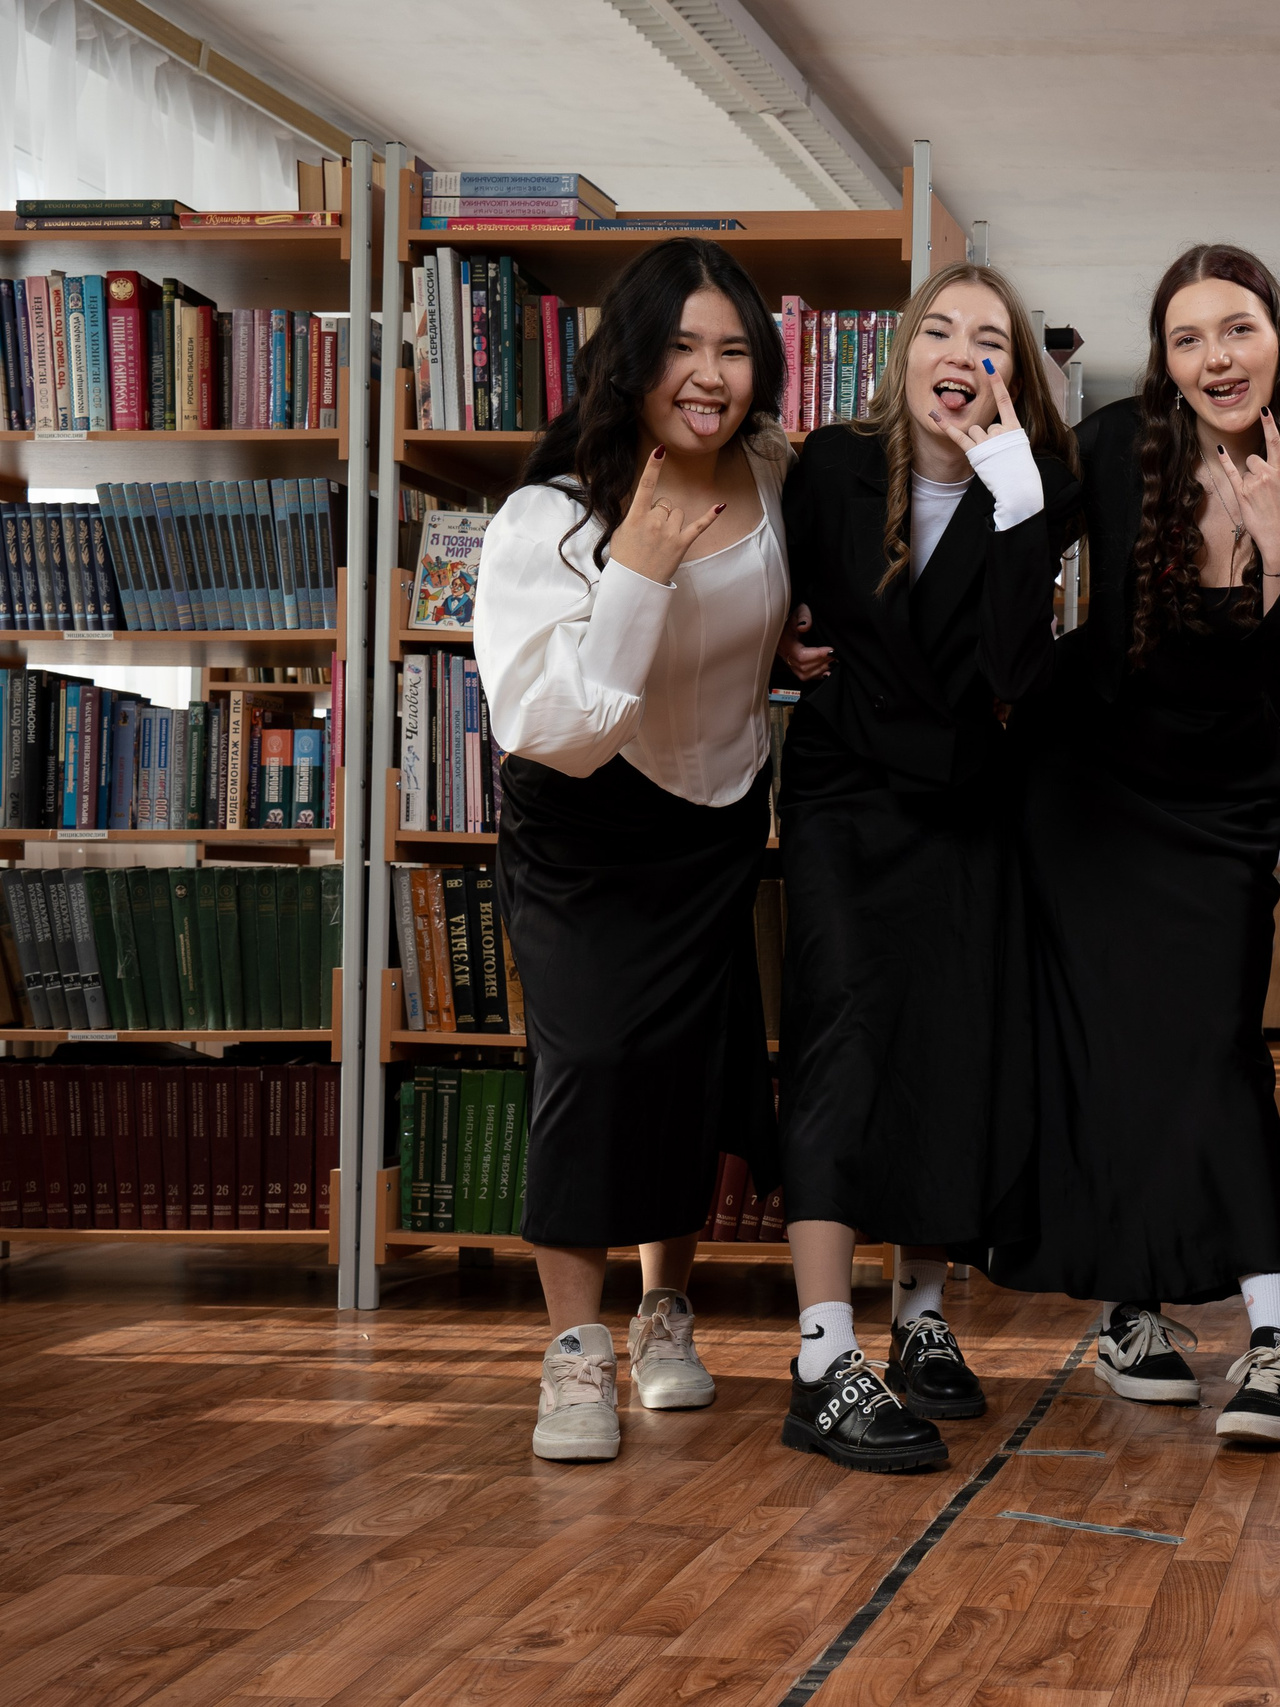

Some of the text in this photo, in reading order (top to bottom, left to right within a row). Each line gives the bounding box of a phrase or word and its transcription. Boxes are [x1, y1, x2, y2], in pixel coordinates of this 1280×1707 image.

[462, 176, 508, 184] ШКОЛЬНИКА
[510, 176, 559, 184] СПРАВОЧНИК
[205, 214, 250, 225] Кулинария
[426, 268, 435, 306] РОССИИ
[31, 296, 47, 385] ВЕЛИКИХ ИМЁН
[87, 295, 101, 384] ВЕЛИКИХ ИМЁН
[429, 308, 438, 356] СЕРЕДИНЕ
[785, 323, 797, 375] ДЕВОЧЕК
[323, 336, 333, 405] Николай КУЗНЕЦОВ
[113, 363, 128, 414] РУССКИЕ
[430, 534, 440, 545] Я
[445, 547, 472, 558] МИР
[27, 675, 37, 743] ИНФОРМАТИКА
[405, 676, 422, 740] Человек
[81, 701, 92, 824] МИРОВАЯ ХУДОЖЕСТВЕННАЯ КУЛЬТУРА
[229, 699, 241, 823] ВИДЕОМОНТАЖ НА ПК
[45, 755, 56, 812] ЕСТЕСТВОЗНАНИЕ
[35, 883, 52, 940] ЭНЦИКЛОПЕДИЯ
[69, 884, 82, 942] МАТЕМАТИЧЕСКАЯ
[76, 883, 91, 940] ЭНЦИКЛОПЕДИЯ
[449, 914, 470, 987] МУЗЫКА
[480, 901, 498, 998] БИОЛОГИЯ
[462, 1104, 475, 1186] ЖИЗНЬ РАСТЕНИЙ
[480, 1104, 496, 1186] ЖИЗНЬ РАСТЕНИЙ
[500, 1103, 516, 1186] ЖИЗНЬ РАСТЕНИЙ
[25, 1180, 37, 1193] 18
[49, 1181, 60, 1194] 19
[74, 1183, 86, 1195] 20
[97, 1183, 108, 1194] 21
[120, 1182, 132, 1194] 22
[143, 1183, 156, 1195] 23
[168, 1184, 179, 1196] 24
[192, 1184, 205, 1195] 25
[216, 1184, 229, 1196] 26
[241, 1184, 254, 1196] 27
[268, 1183, 281, 1194] 28
[293, 1183, 307, 1195] 29
[462, 1188, 469, 1199] 1
[479, 1188, 488, 1200] 2
[498, 1186, 508, 1199] 3
[438, 1201, 446, 1212] 2
[819, 1376, 878, 1431] SPOR
